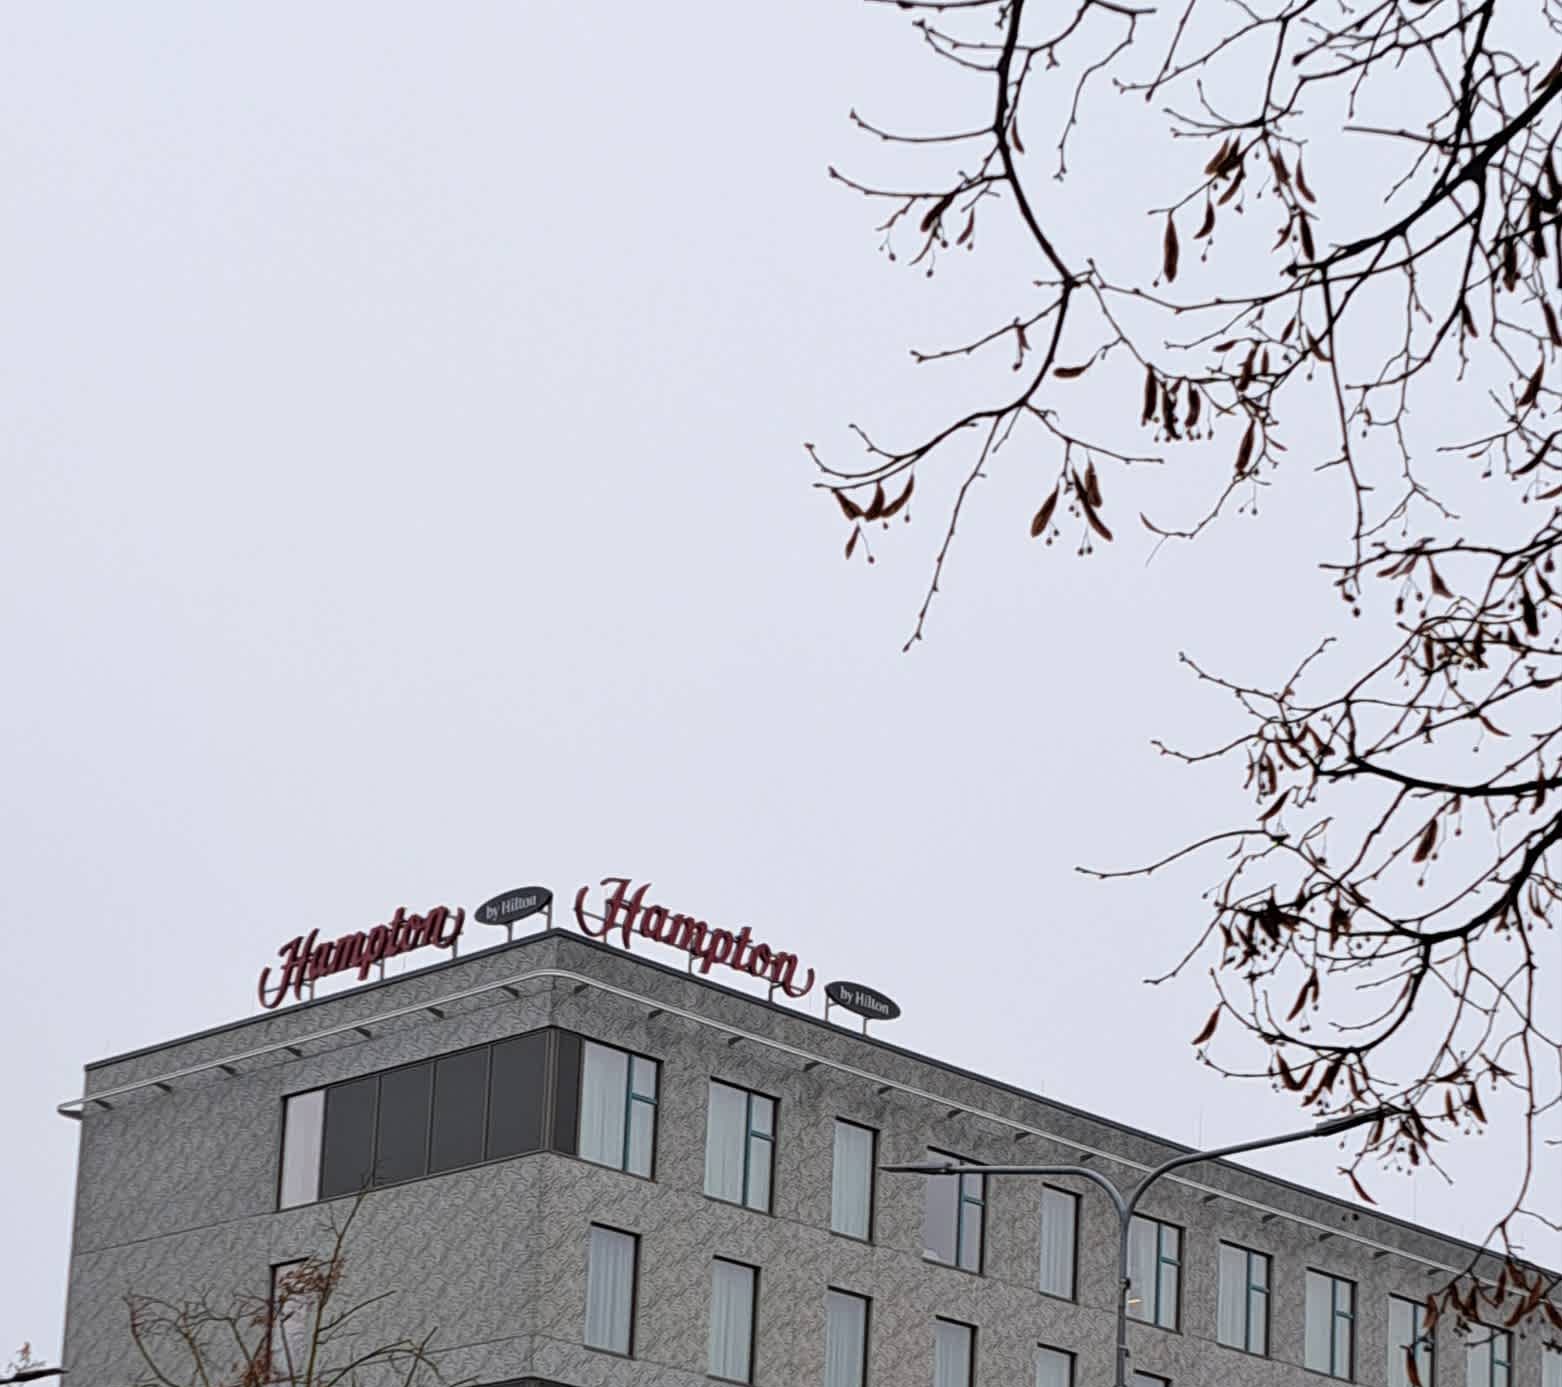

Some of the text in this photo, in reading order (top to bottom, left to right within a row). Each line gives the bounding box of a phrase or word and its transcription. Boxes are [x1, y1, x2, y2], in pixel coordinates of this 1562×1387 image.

[485, 895, 537, 921] by Hilton
[575, 877, 815, 998] Hampton
[258, 905, 465, 1009] Hampton
[840, 985, 889, 1015] by Hilton
